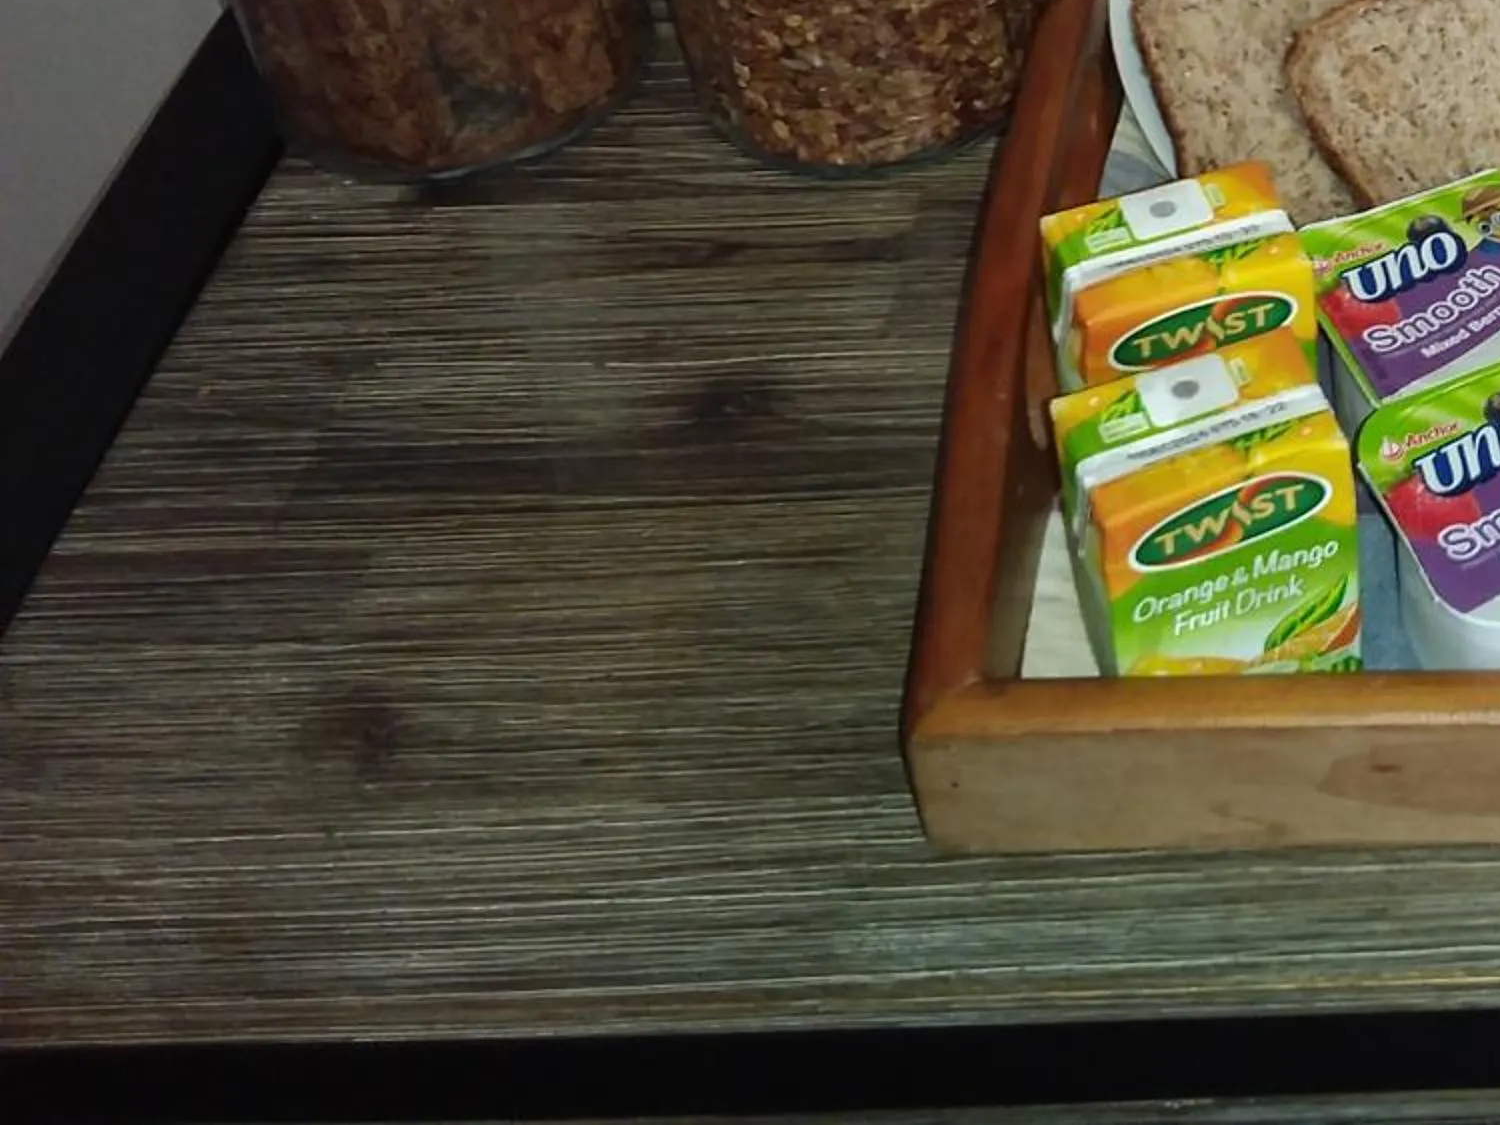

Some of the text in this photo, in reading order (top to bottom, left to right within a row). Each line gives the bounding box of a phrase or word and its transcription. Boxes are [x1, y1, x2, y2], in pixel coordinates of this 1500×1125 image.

[1132, 302, 1277, 360] TWIST
[1420, 326, 1471, 361] Mixed
[1154, 484, 1305, 556] TWIST
[1132, 539, 1340, 624] Orange & Mango
[1173, 574, 1305, 637] Fruit Drink
